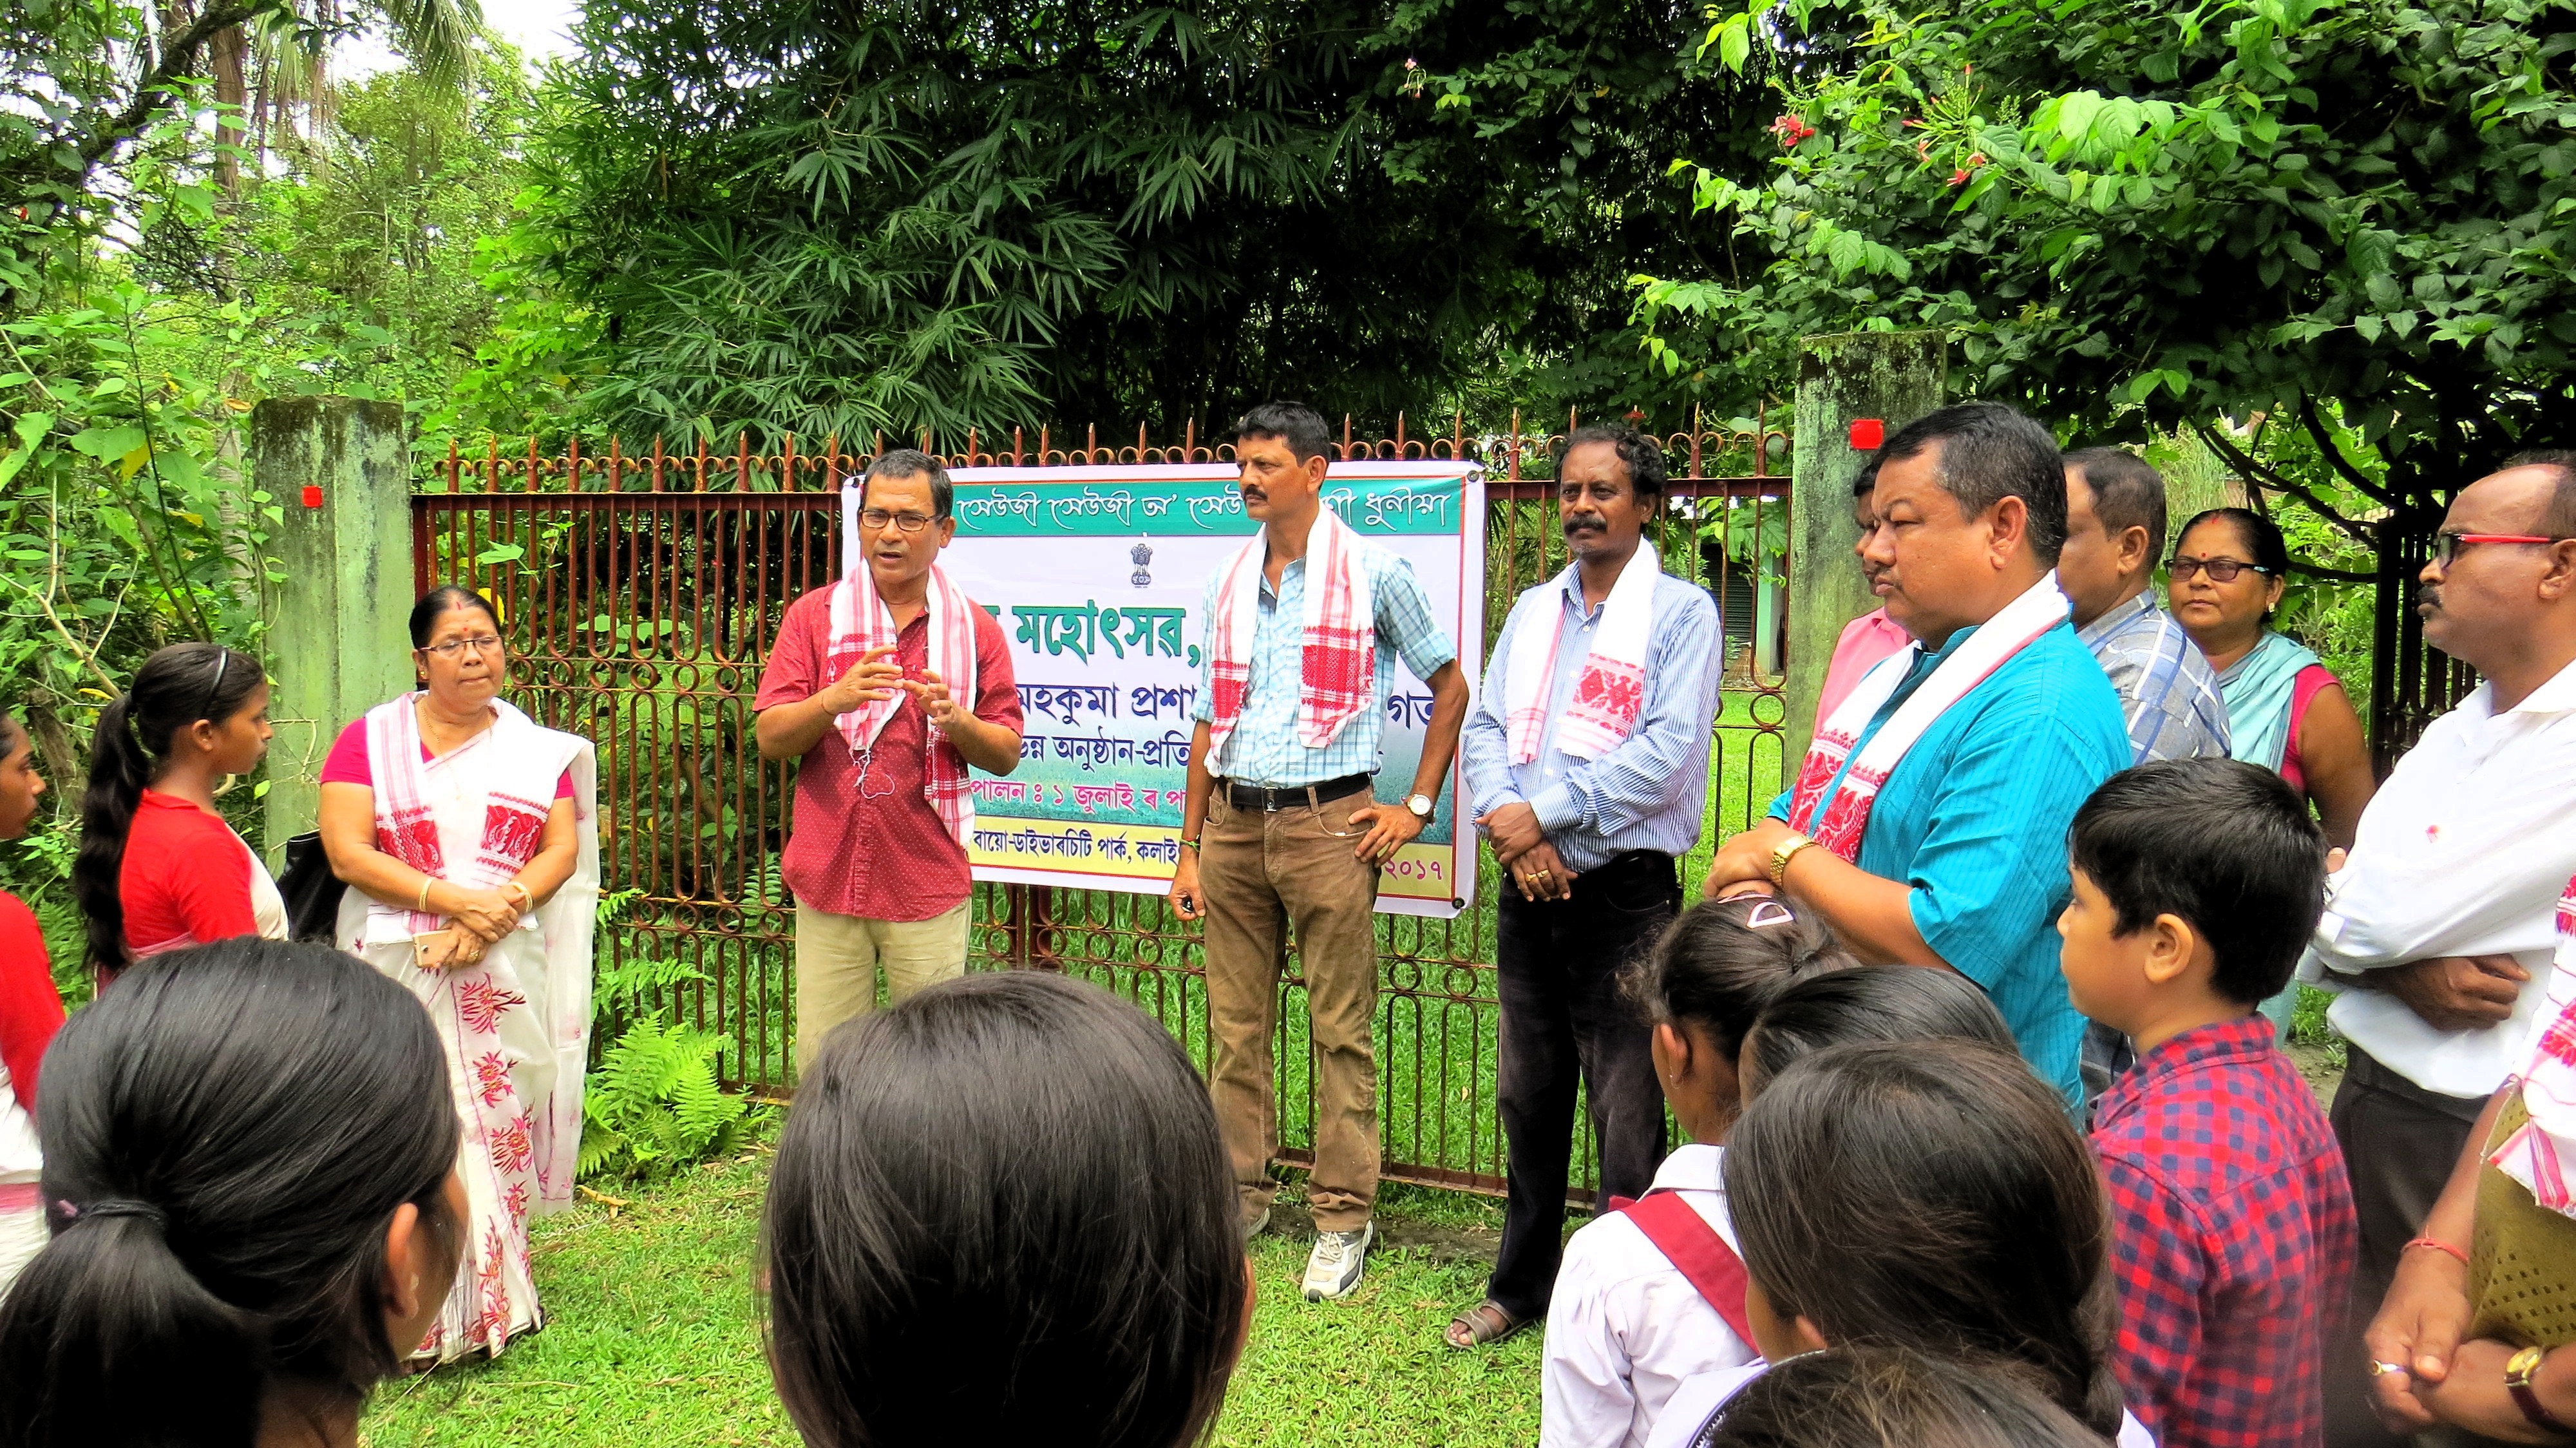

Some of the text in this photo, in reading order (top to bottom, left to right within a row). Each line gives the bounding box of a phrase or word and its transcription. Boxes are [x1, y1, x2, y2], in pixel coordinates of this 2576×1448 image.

[1186, 484, 1242, 529] সেউ
[1365, 486, 1451, 531] ধুনীয়া
[1132, 682, 1197, 721] প্ৰশা
[1051, 725, 1191, 773] অনুষ্ঠান-প্ৰতি
[1073, 780, 1136, 814] জুলাই
[1135, 835, 1180, 867] কলাই
[1385, 859, 1442, 881] ২০১৭
